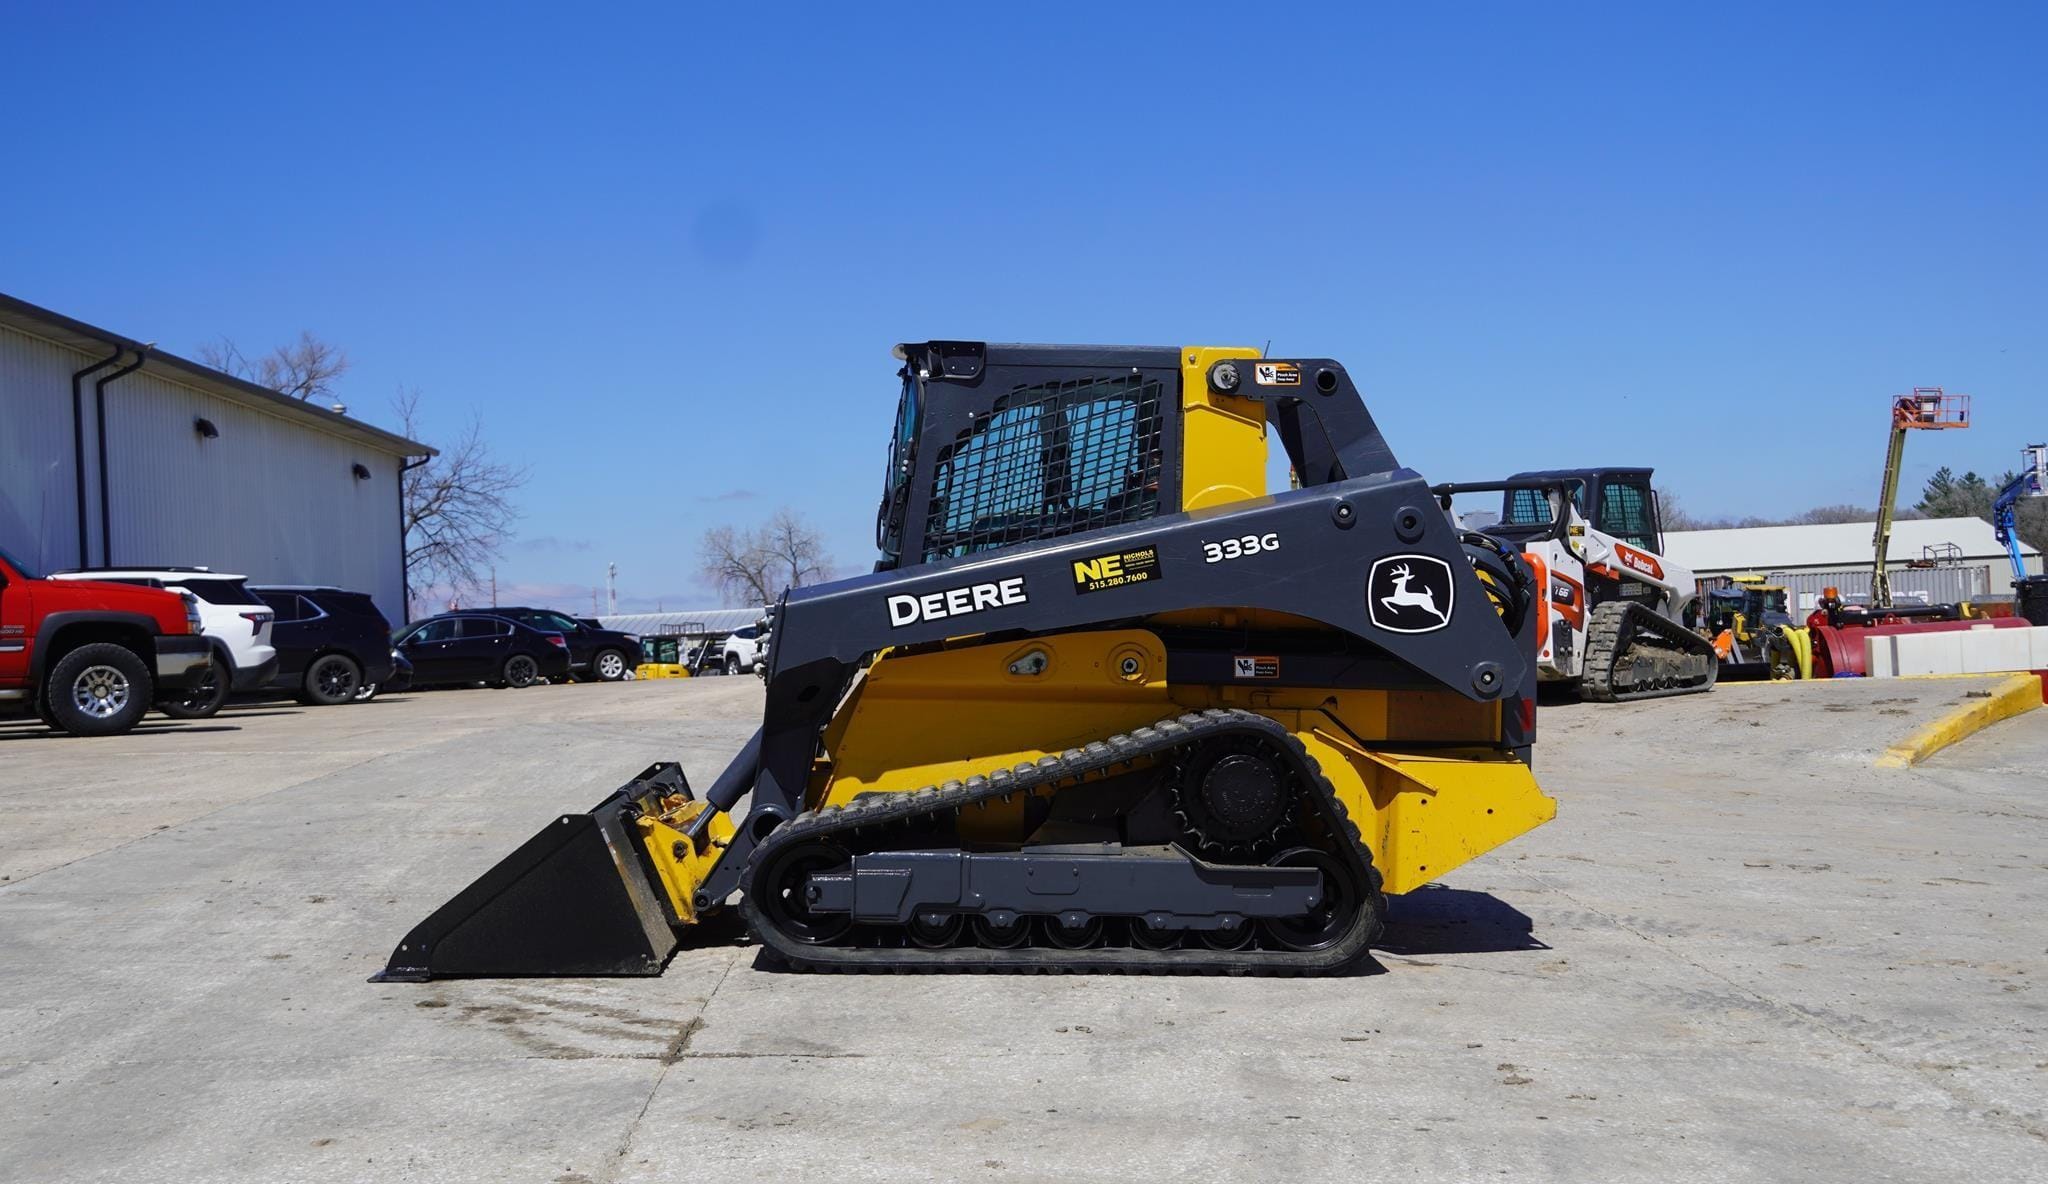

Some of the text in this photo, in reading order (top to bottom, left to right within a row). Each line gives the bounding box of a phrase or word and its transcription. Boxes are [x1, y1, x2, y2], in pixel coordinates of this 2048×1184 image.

[1123, 549, 1154, 560] NICHOLS
[1203, 533, 1280, 563] 333G
[1074, 555, 1124, 583] NE
[1089, 572, 1148, 590] 515.280.7600
[887, 577, 1027, 627] DEERE
